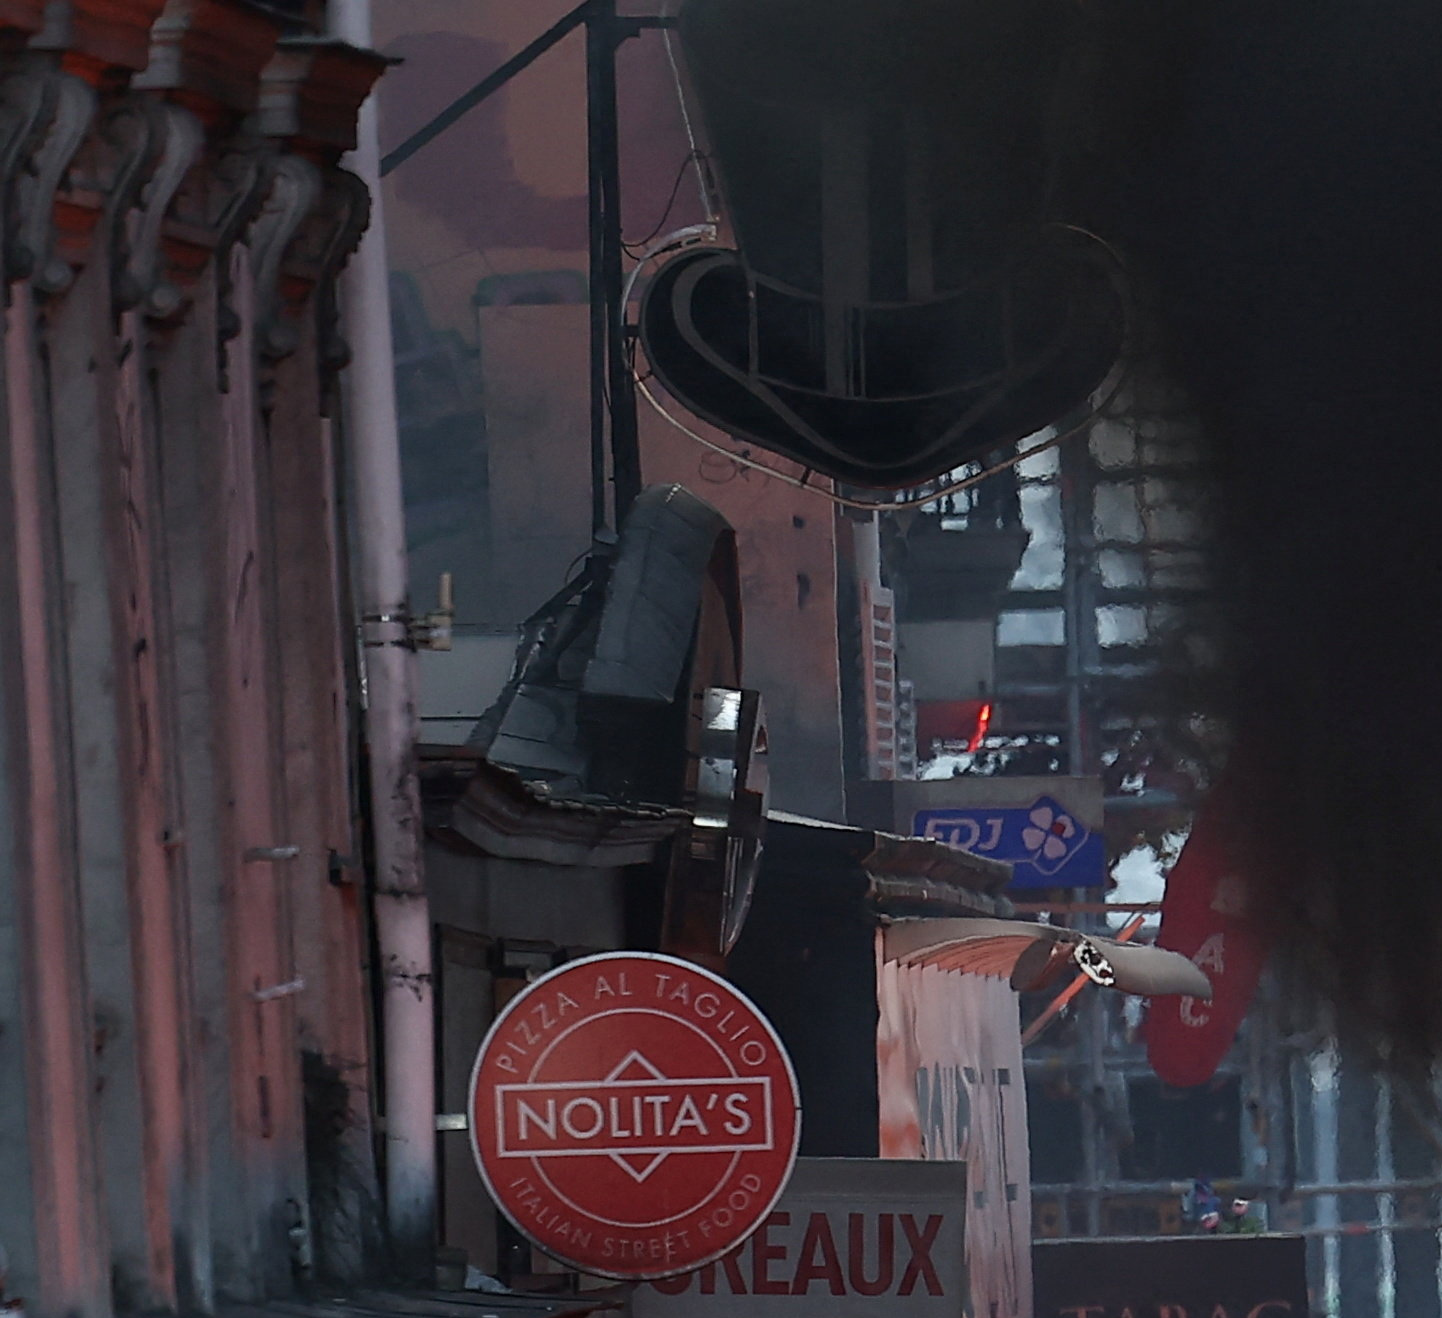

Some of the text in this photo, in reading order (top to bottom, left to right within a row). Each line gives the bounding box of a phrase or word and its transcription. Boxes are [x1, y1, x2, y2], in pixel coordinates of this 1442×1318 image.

[924, 817, 1005, 851] FDJ
[495, 972, 768, 1074] PIZZA AL TAGLIO
[515, 1092, 752, 1141] NOLITA'S
[509, 1172, 763, 1260] ITALIAN STREET FOOD
[647, 1211, 946, 1297] REAUX
